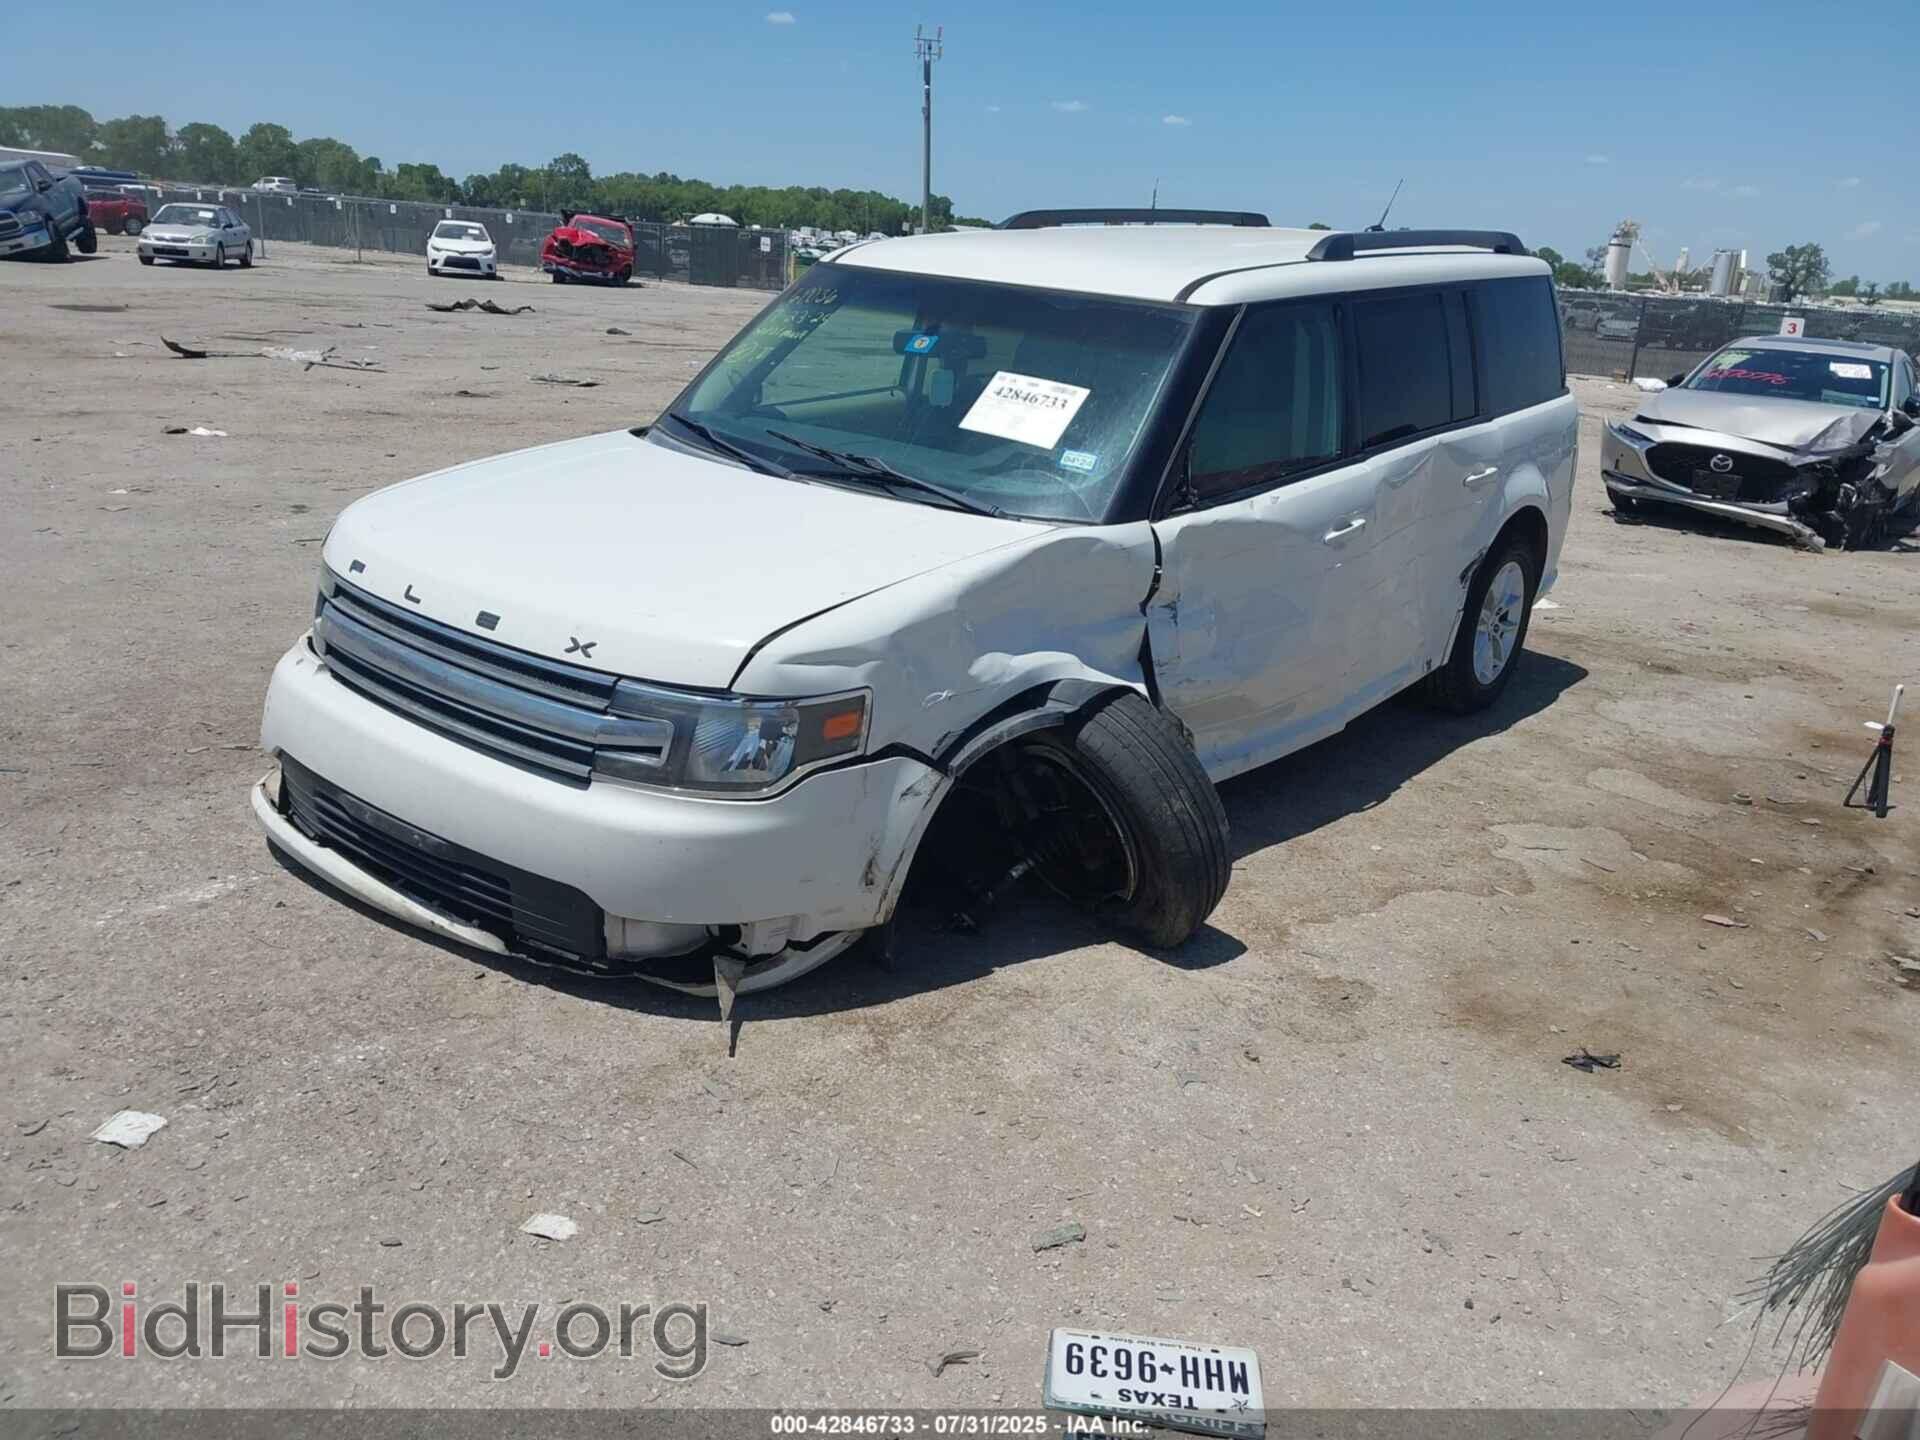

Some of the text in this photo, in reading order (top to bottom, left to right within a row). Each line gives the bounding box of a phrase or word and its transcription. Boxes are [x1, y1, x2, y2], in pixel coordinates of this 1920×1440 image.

[1787, 322, 1797, 335] 3
[993, 386, 1069, 411] 42846733
[349, 558, 598, 659] FLEX
[1117, 1387, 1199, 1411] TEXAS
